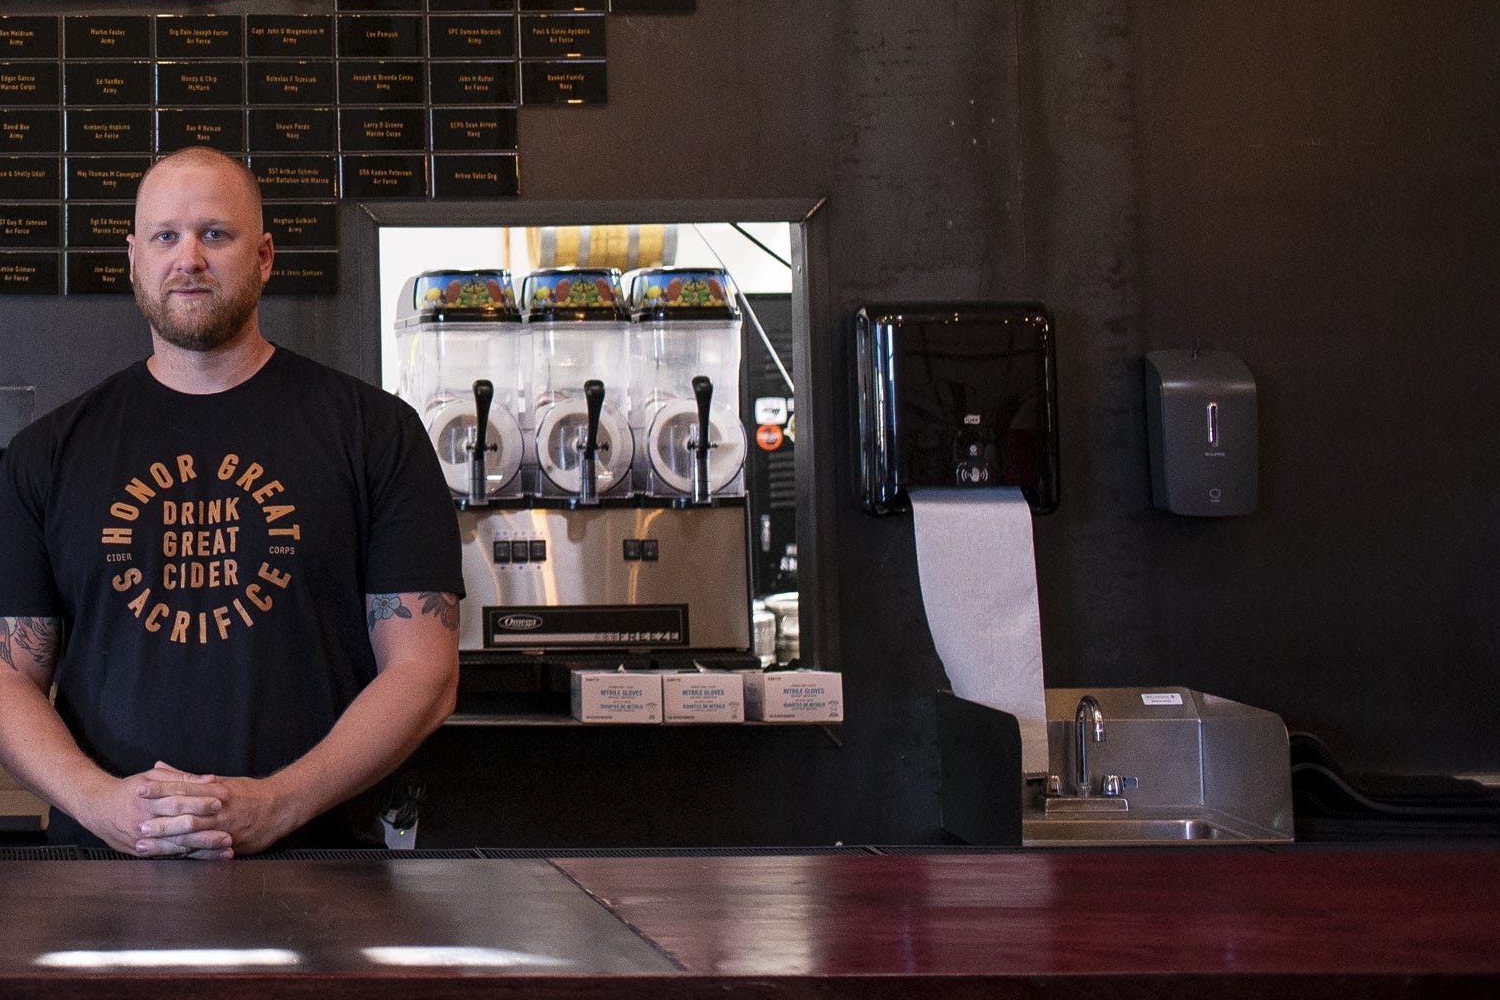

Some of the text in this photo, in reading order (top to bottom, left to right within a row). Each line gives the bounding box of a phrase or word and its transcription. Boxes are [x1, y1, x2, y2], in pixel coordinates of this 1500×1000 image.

[101, 453, 301, 545] HONOR GREAT
[163, 497, 240, 526] DRINK
[106, 546, 296, 562] CIDER CORPS
[163, 526, 240, 558] GREAT
[163, 559, 239, 590] CIDER
[112, 561, 292, 644] SACRIFICE
[621, 689, 643, 697] GLOVES
